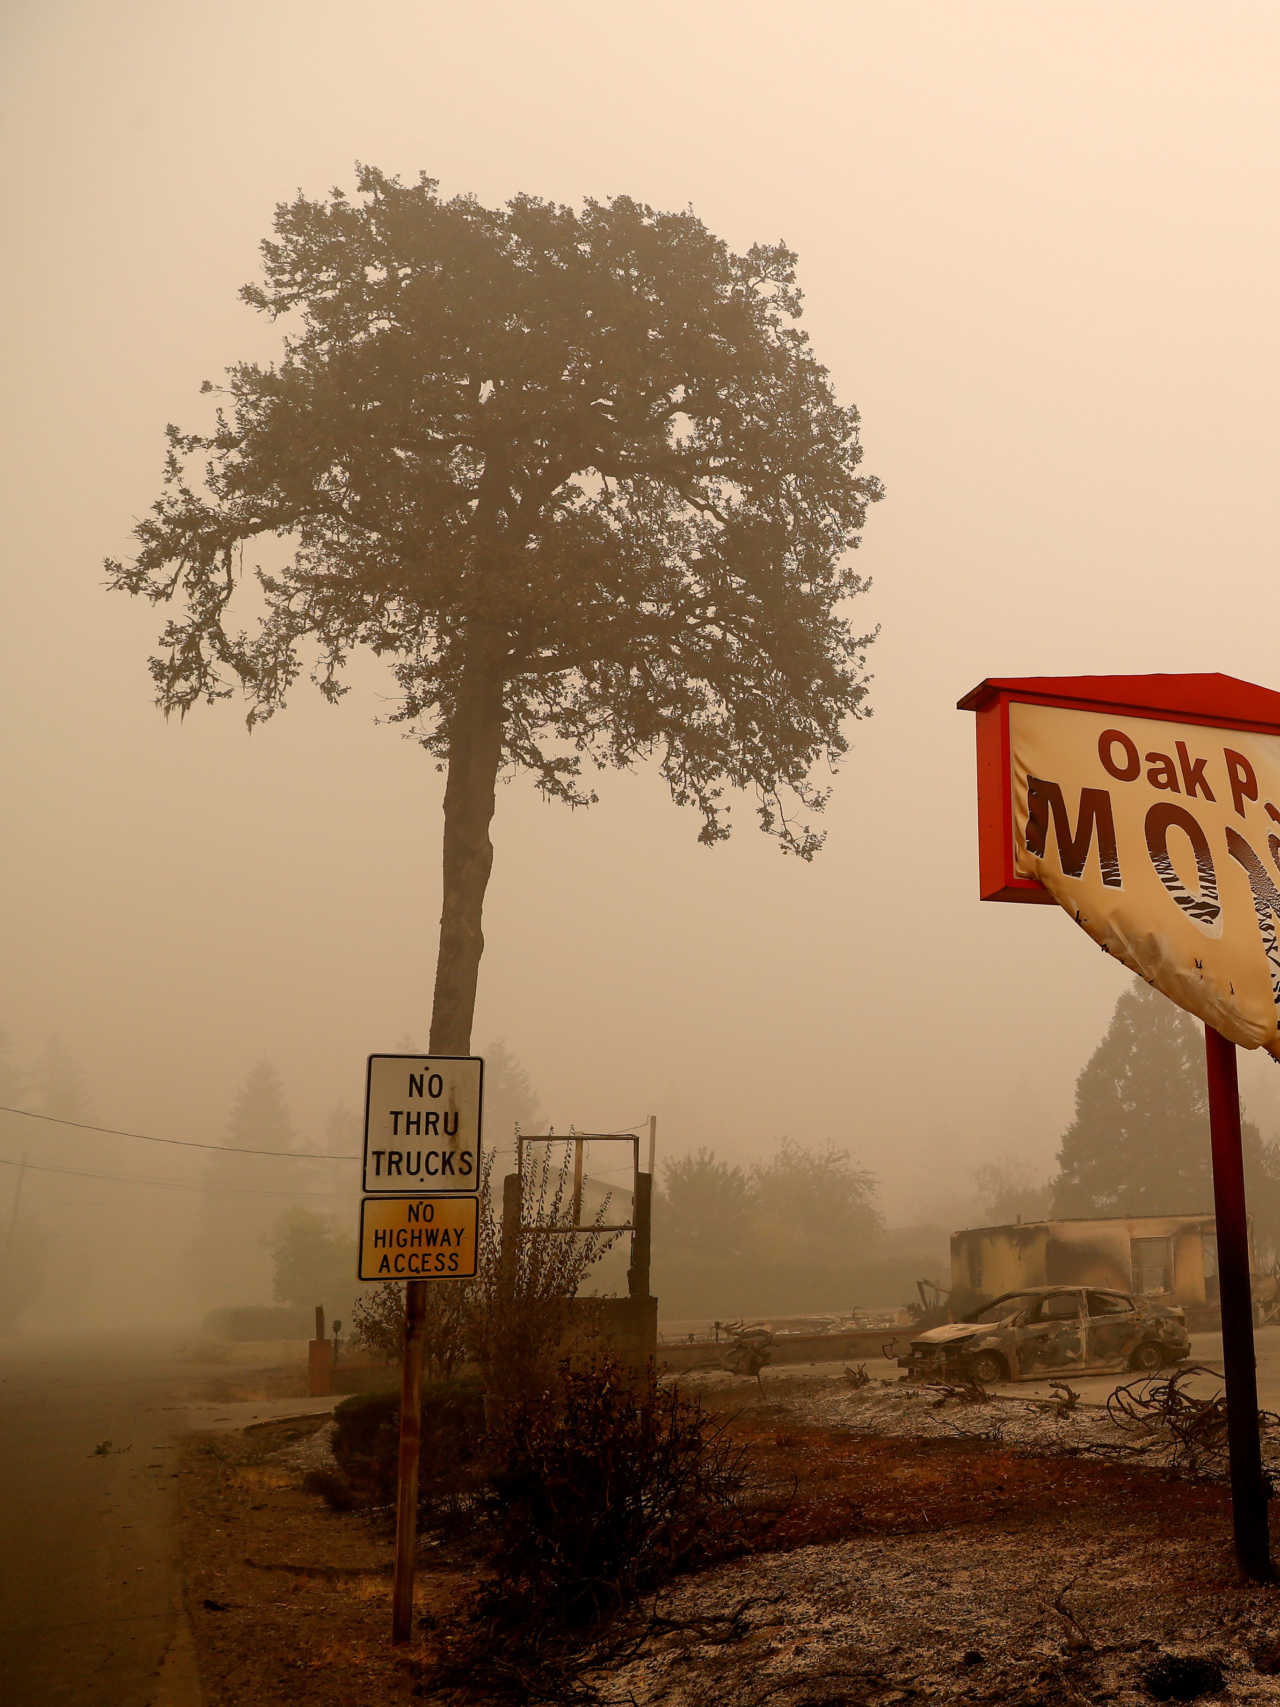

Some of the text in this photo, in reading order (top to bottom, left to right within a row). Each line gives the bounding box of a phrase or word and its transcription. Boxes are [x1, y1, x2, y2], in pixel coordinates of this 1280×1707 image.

[1098, 728, 1217, 803] Oak
[409, 1073, 443, 1099] NO
[390, 1111, 459, 1136] THRU
[372, 1151, 473, 1176] TRUCKS
[408, 1204, 434, 1223] NO
[374, 1228, 465, 1248] HIGHWAY
[378, 1253, 459, 1273] ACCESS
